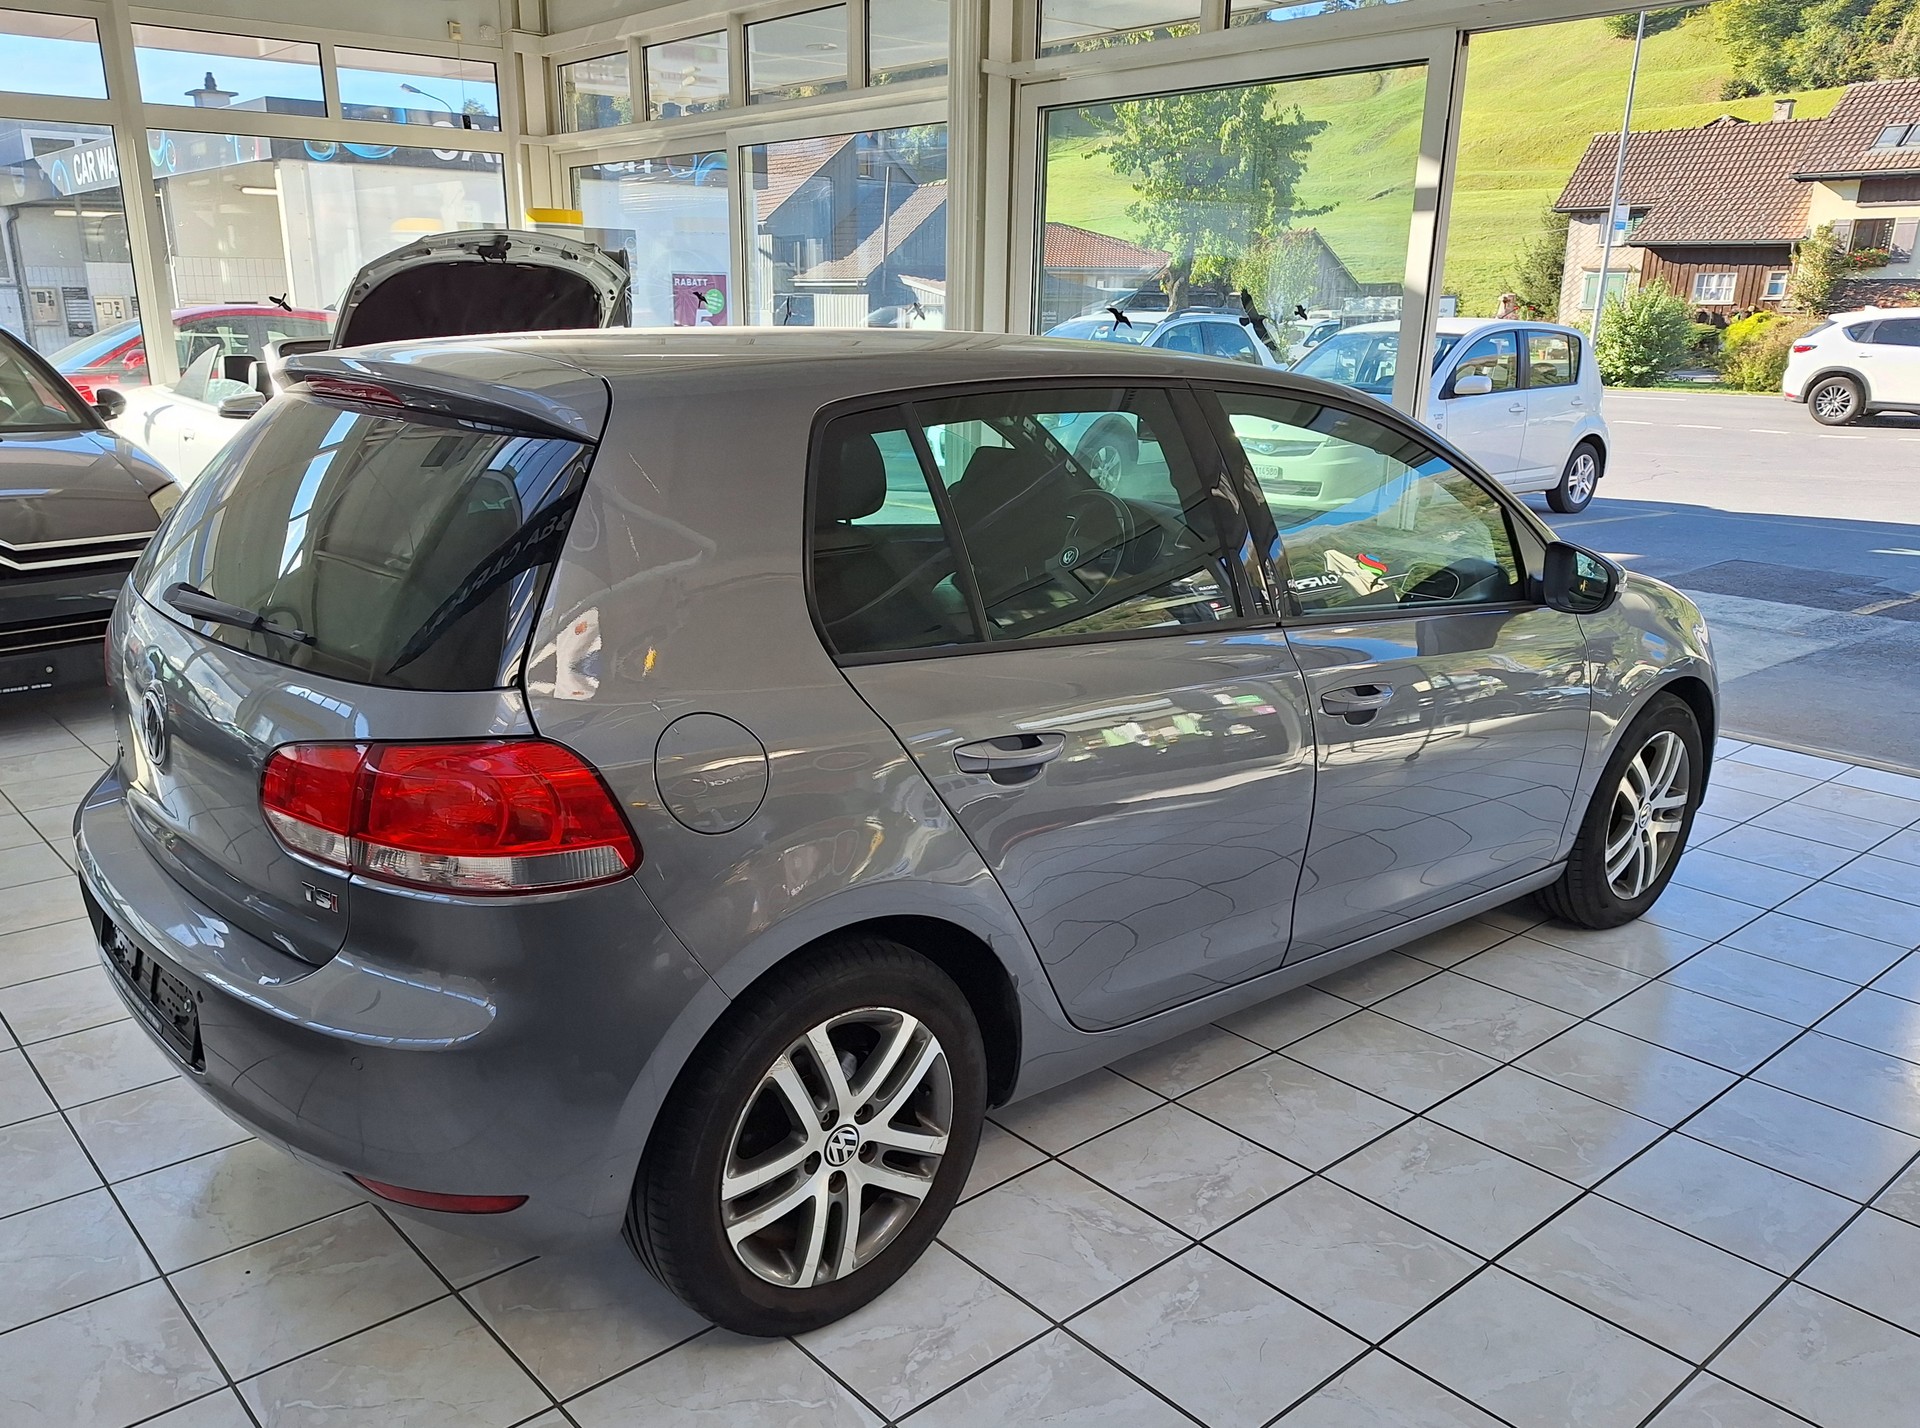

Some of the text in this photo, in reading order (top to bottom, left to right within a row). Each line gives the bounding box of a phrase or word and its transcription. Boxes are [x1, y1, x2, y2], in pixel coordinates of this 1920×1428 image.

[73, 151, 98, 186] CAR
[674, 278, 708, 287] RABATT
[301, 880, 339, 913] TSI
